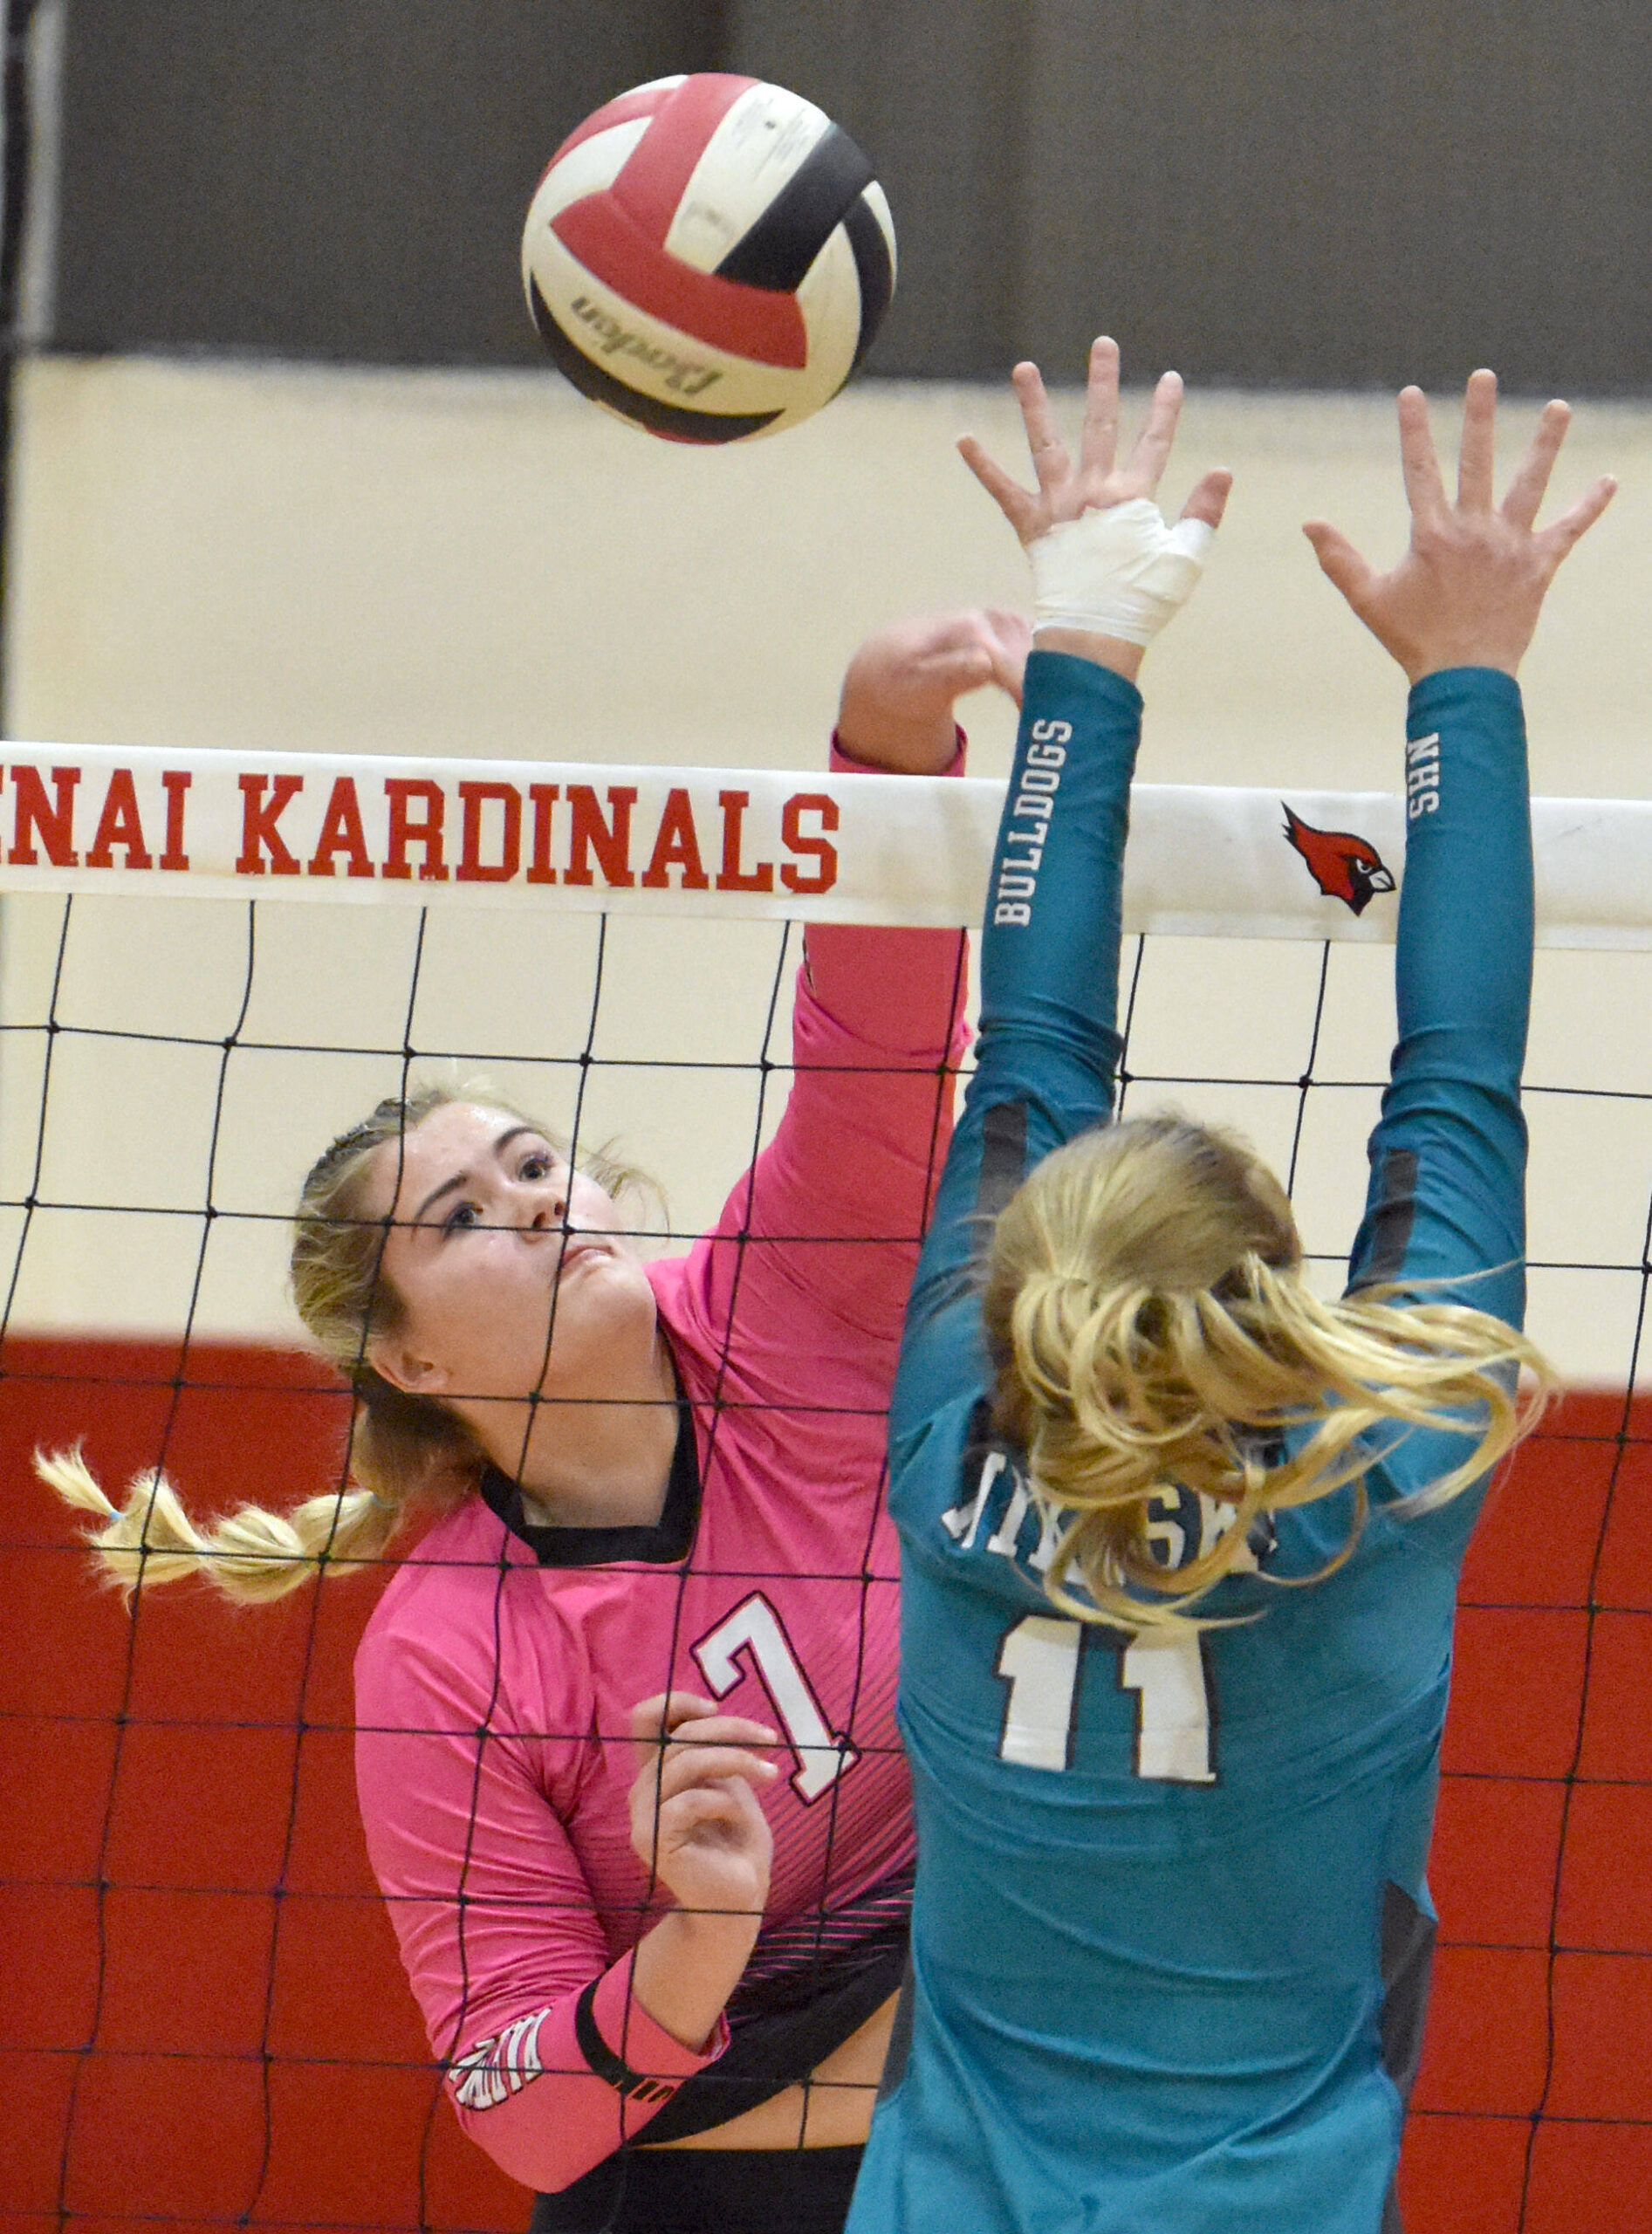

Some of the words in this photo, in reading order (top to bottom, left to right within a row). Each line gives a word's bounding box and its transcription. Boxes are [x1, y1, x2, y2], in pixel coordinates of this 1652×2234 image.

[570, 295, 723, 396] Baden
[0, 764, 193, 870] NAI
[236, 772, 840, 894] KARDINALS
[994, 718, 1073, 928] BULLDOGS
[1406, 731, 1440, 819] NHS
[689, 1590, 862, 1806] 7
[997, 1615, 1217, 1783] 11
